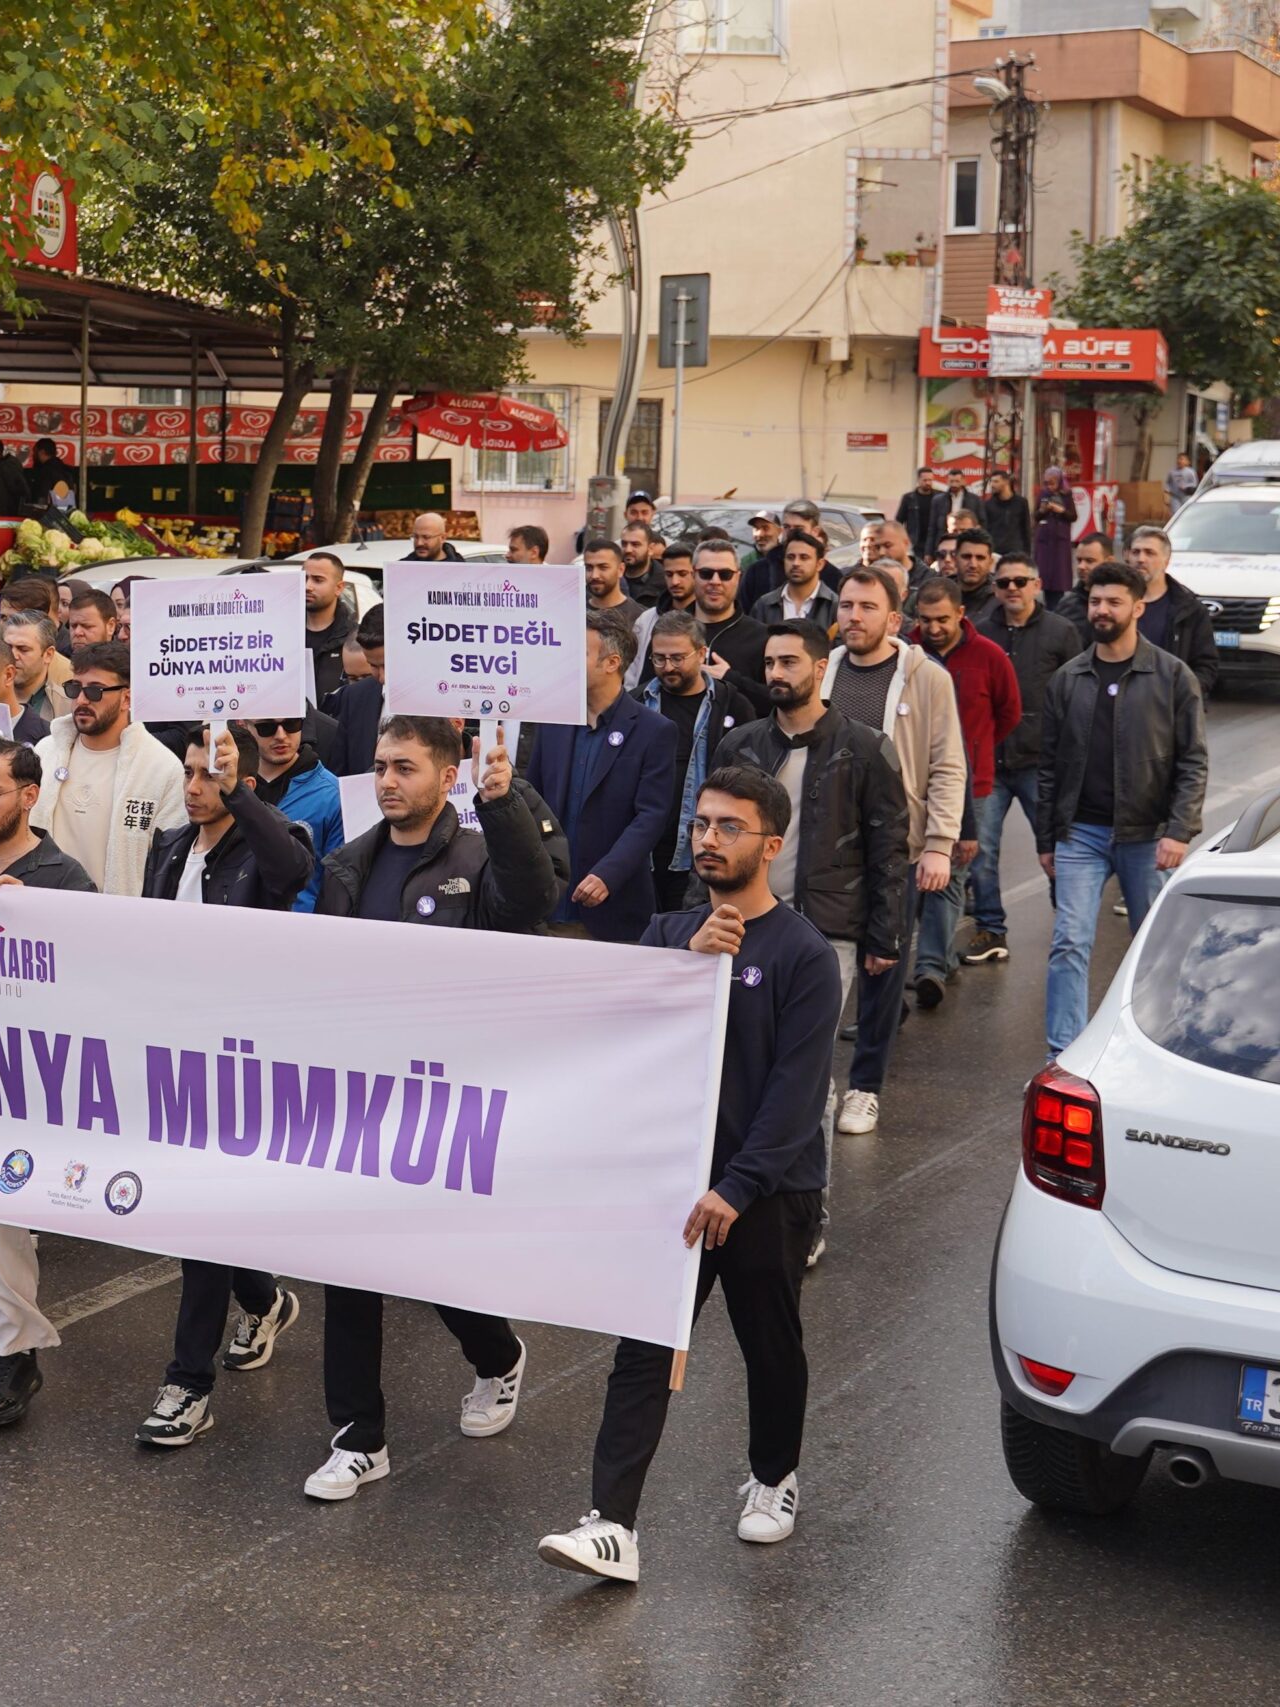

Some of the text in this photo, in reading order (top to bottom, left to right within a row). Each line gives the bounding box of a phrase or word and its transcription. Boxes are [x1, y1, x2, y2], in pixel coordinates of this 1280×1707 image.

[995, 288, 1043, 300] TUZLA
[1000, 298, 1038, 308] SPOT
[1063, 336, 1132, 355] BÜFE
[449, 398, 486, 409] ALGIDA
[509, 407, 542, 423] ALGIDA
[427, 591, 452, 605] KADINA
[169, 604, 190, 618] KADINA
[407, 616, 562, 647] ŞİDDET DEĞİL
[159, 630, 273, 656] ŞİDDETSİZ BİR
[149, 653, 285, 677] DÜNYA MÜMKÜN
[450, 650, 518, 675] SEVGİ
[146, 1036, 509, 1196] MÜMKÜN
[1125, 1128, 1231, 1157] SANDERO
[1245, 1398, 1263, 1412] TR
